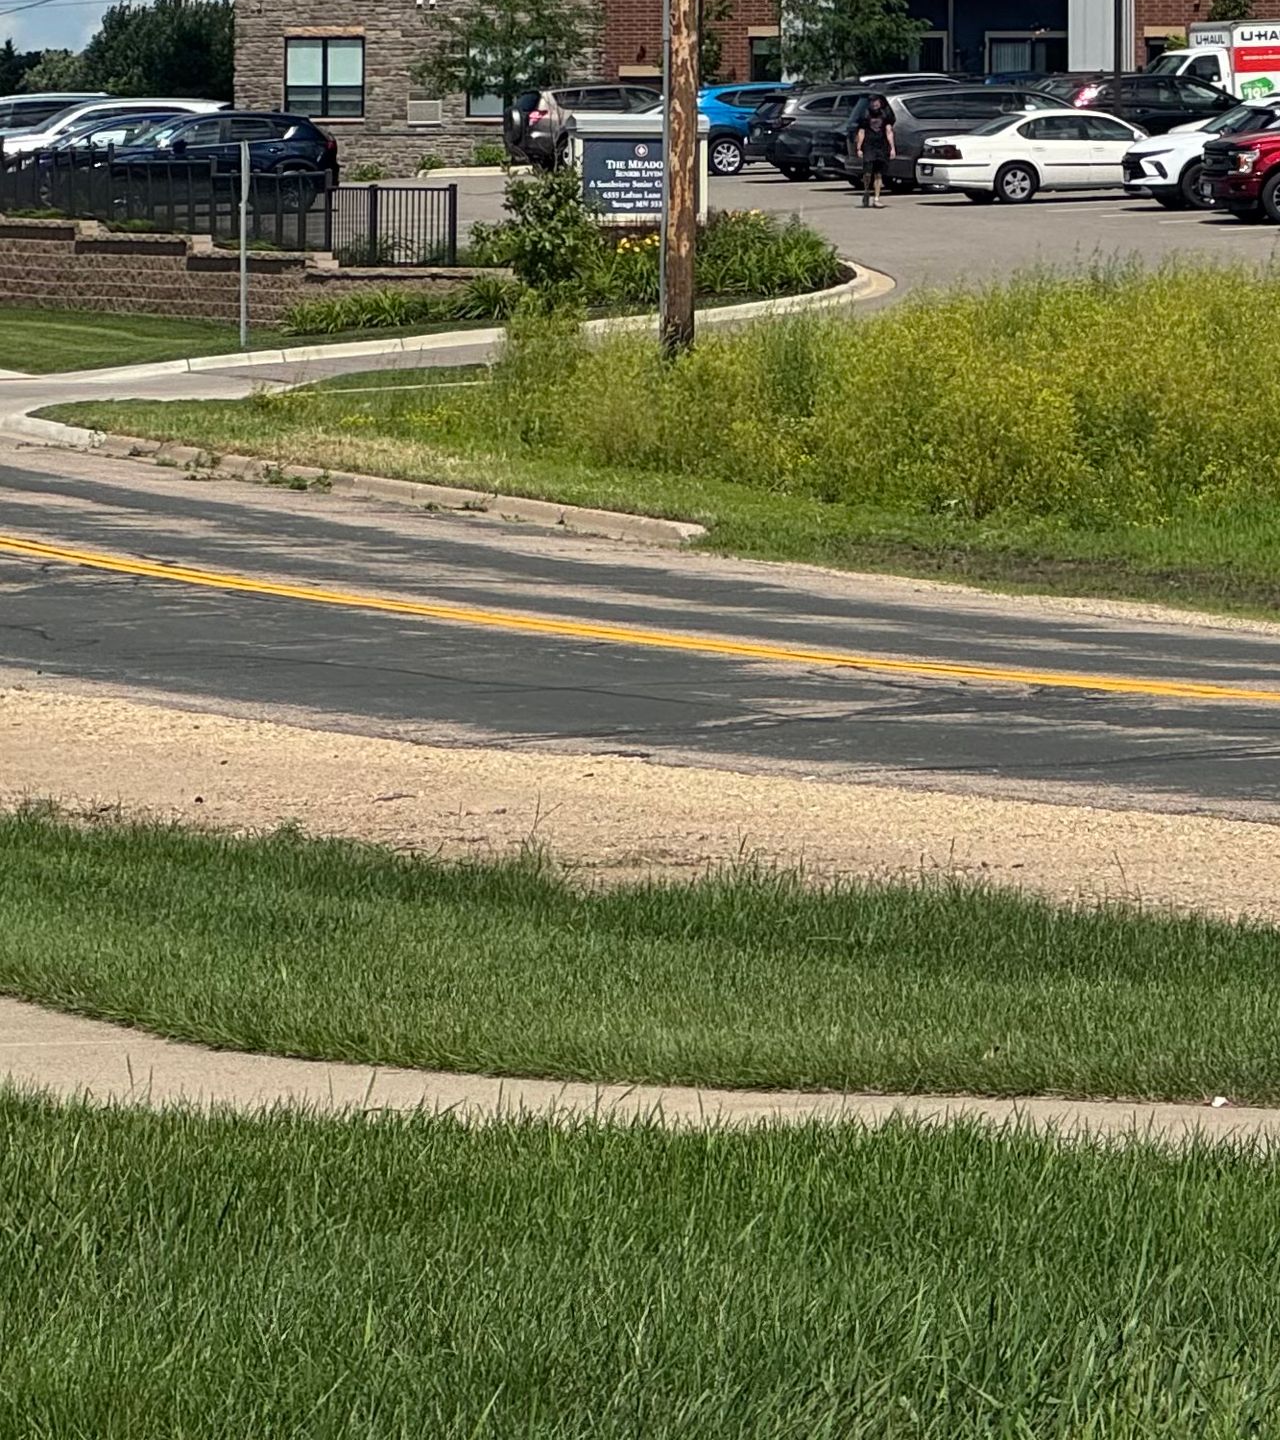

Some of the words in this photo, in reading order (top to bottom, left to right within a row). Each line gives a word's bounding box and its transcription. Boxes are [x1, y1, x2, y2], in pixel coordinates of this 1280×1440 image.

[1195, 34, 1225, 45] U-HAUL
[605, 160, 626, 169] THE
[628, 160, 664, 169] MEADO
[589, 180, 596, 188] A
[650, 200, 663, 208] 553
